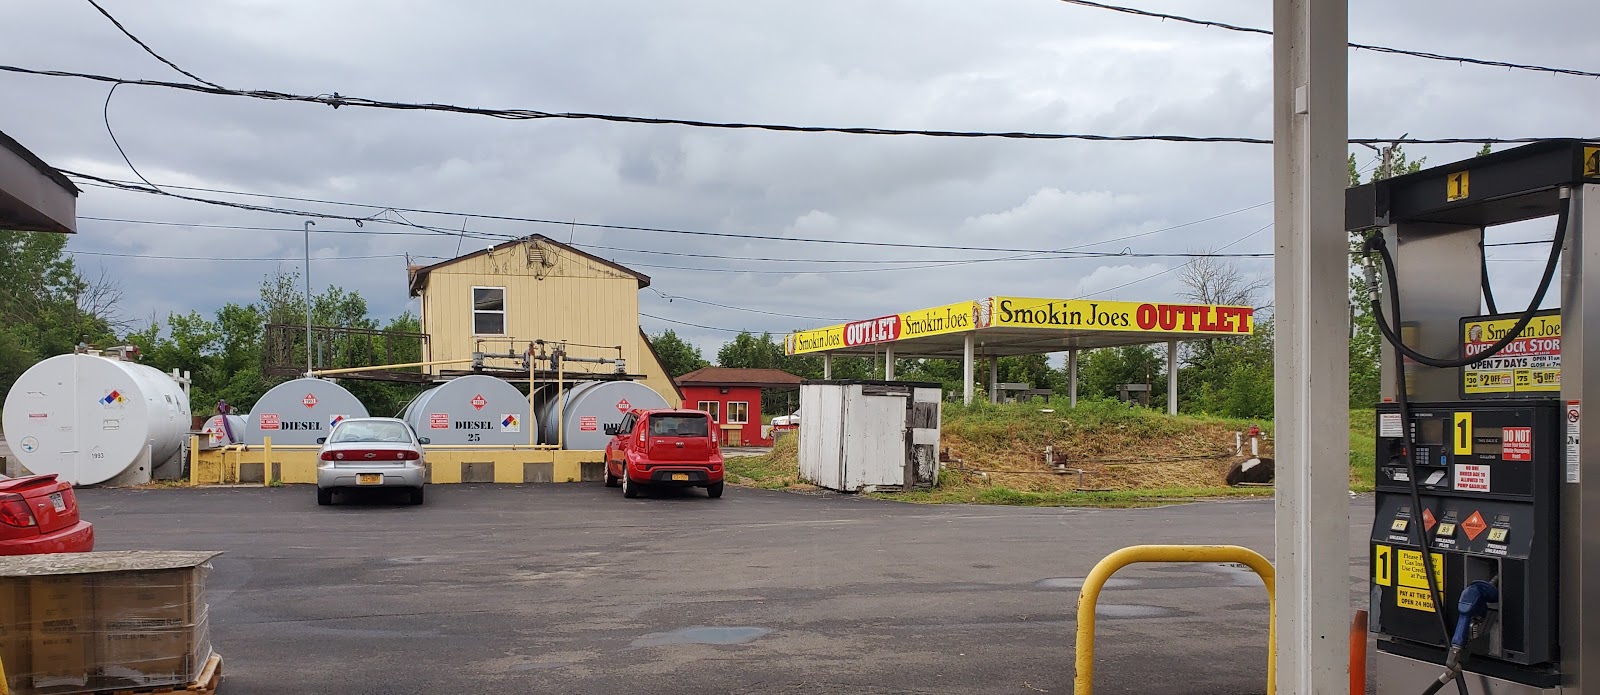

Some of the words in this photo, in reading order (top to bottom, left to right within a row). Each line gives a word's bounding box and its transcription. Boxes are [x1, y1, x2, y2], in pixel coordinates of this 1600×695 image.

[1454, 173, 1462, 195] 1
[1000, 300, 1081, 325] Smokin
[1136, 303, 1253, 333] OUTLET
[798, 332, 824, 351] Smokin
[846, 316, 897, 345] OUTLET
[905, 311, 943, 335] Smokin
[1487, 321, 1535, 340] Smoin
[1538, 319, 1561, 336] Joe
[1529, 339, 1561, 352] STOR
[1471, 360, 1493, 369] OPEN
[1494, 360, 1503, 369] 7
[1504, 358, 1528, 369] DAYS
[1480, 374, 1490, 386] $2
[1490, 374, 1501, 382] OFF
[1532, 372, 1543, 384] $5
[1544, 372, 1555, 380] OFF
[281, 421, 323, 431] DIESEL
[455, 421, 494, 430] DIESEL
[467, 433, 481, 442] 25
[1457, 418, 1467, 449] 1
[1504, 429, 1514, 443] DO
[1515, 429, 1531, 443] NOT
[1379, 551, 1388, 580] 1
[1401, 598, 1414, 606] OPEN
